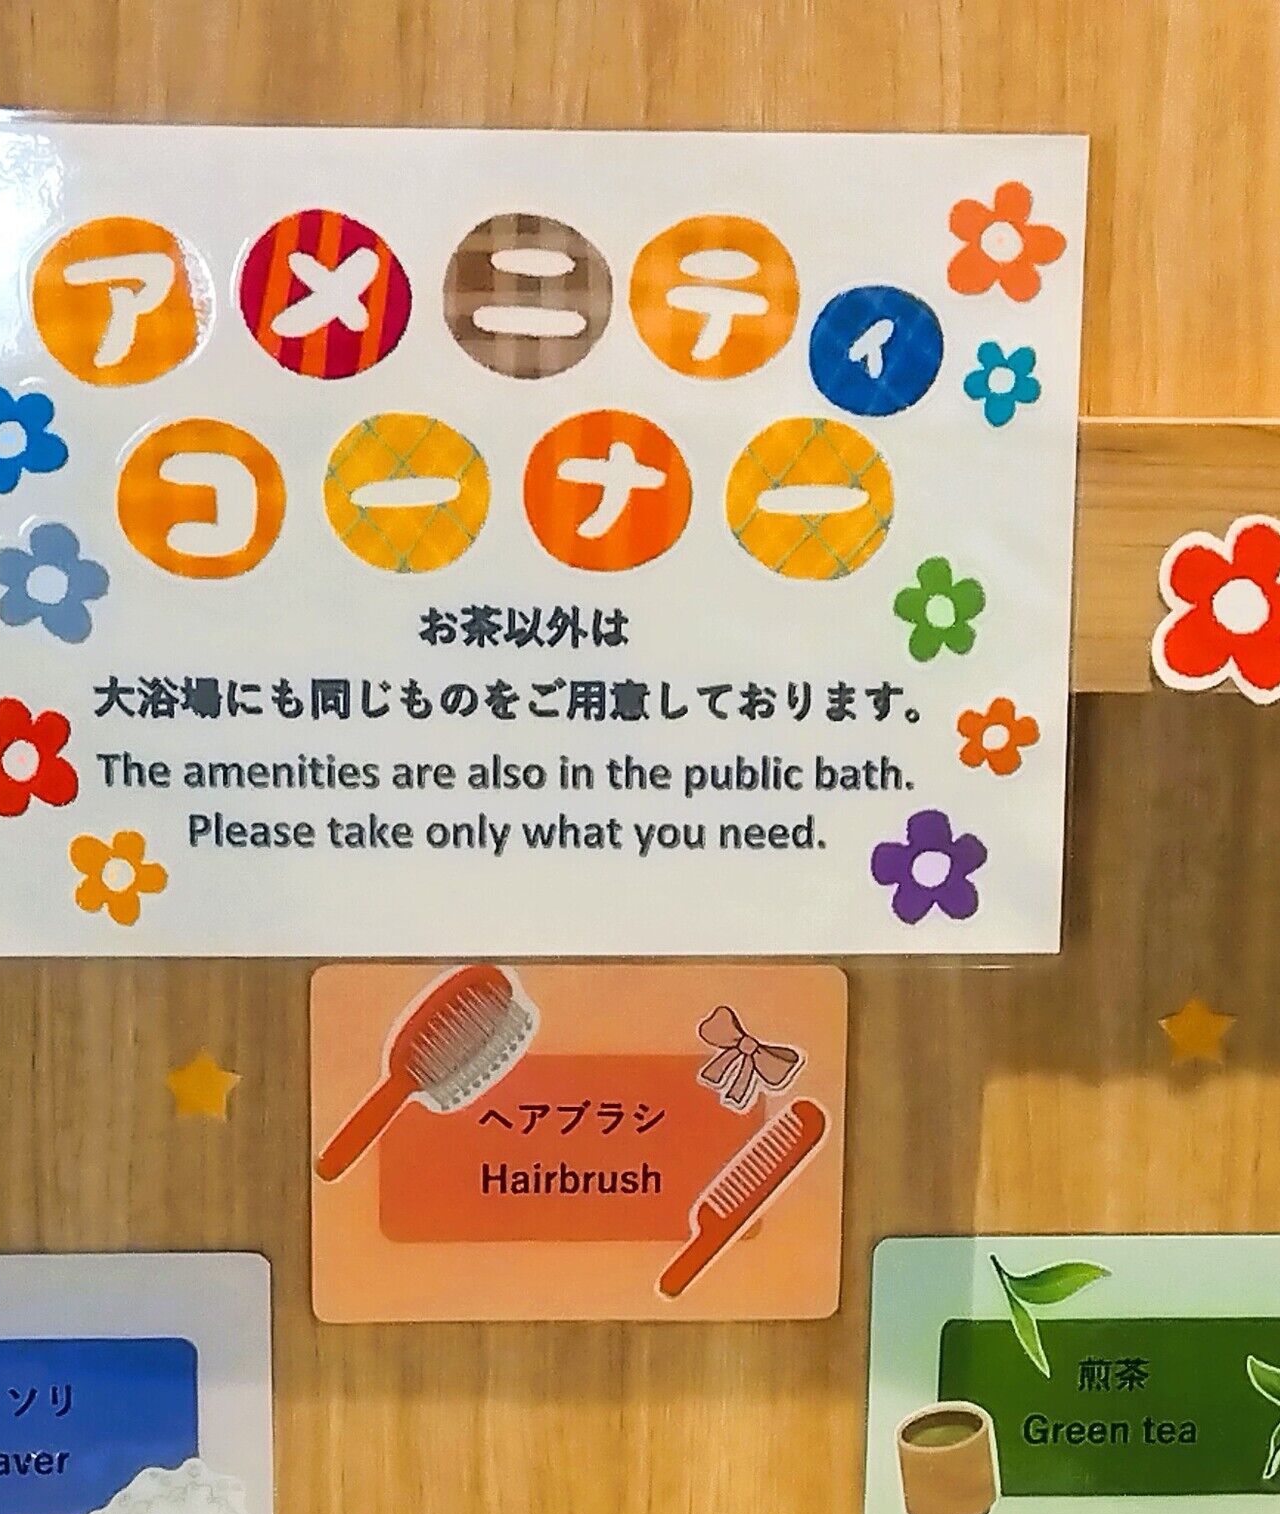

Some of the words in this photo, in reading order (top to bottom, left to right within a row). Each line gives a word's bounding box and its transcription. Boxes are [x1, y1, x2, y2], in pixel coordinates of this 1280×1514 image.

[64, 246, 893, 380] アメニティ
[158, 441, 871, 560] コーナー
[418, 604, 629, 649] お茶以外は
[92, 675, 921, 724] 大浴場にも同じものをご用意しております。
[95, 750, 172, 788] The
[183, 753, 380, 790] amenities
[392, 763, 456, 790] are
[467, 753, 547, 790] also
[559, 754, 594, 790] in
[606, 754, 672, 790] the
[684, 755, 803, 799] public
[815, 755, 914, 791] bath.
[188, 811, 315, 849] Please
[327, 812, 414, 849] take
[426, 813, 511, 856] only
[521, 813, 623, 849] what
[633, 823, 706, 857] you
[719, 814, 826, 850] need.
[478, 1099, 666, 1135] ヘアブラシ
[482, 1161, 662, 1195] Hairbrush
[1078, 1357, 1150, 1393] 煎茶
[1022, 1414, 1130, 1445] Green
[1143, 1416, 1198, 1445] tea
